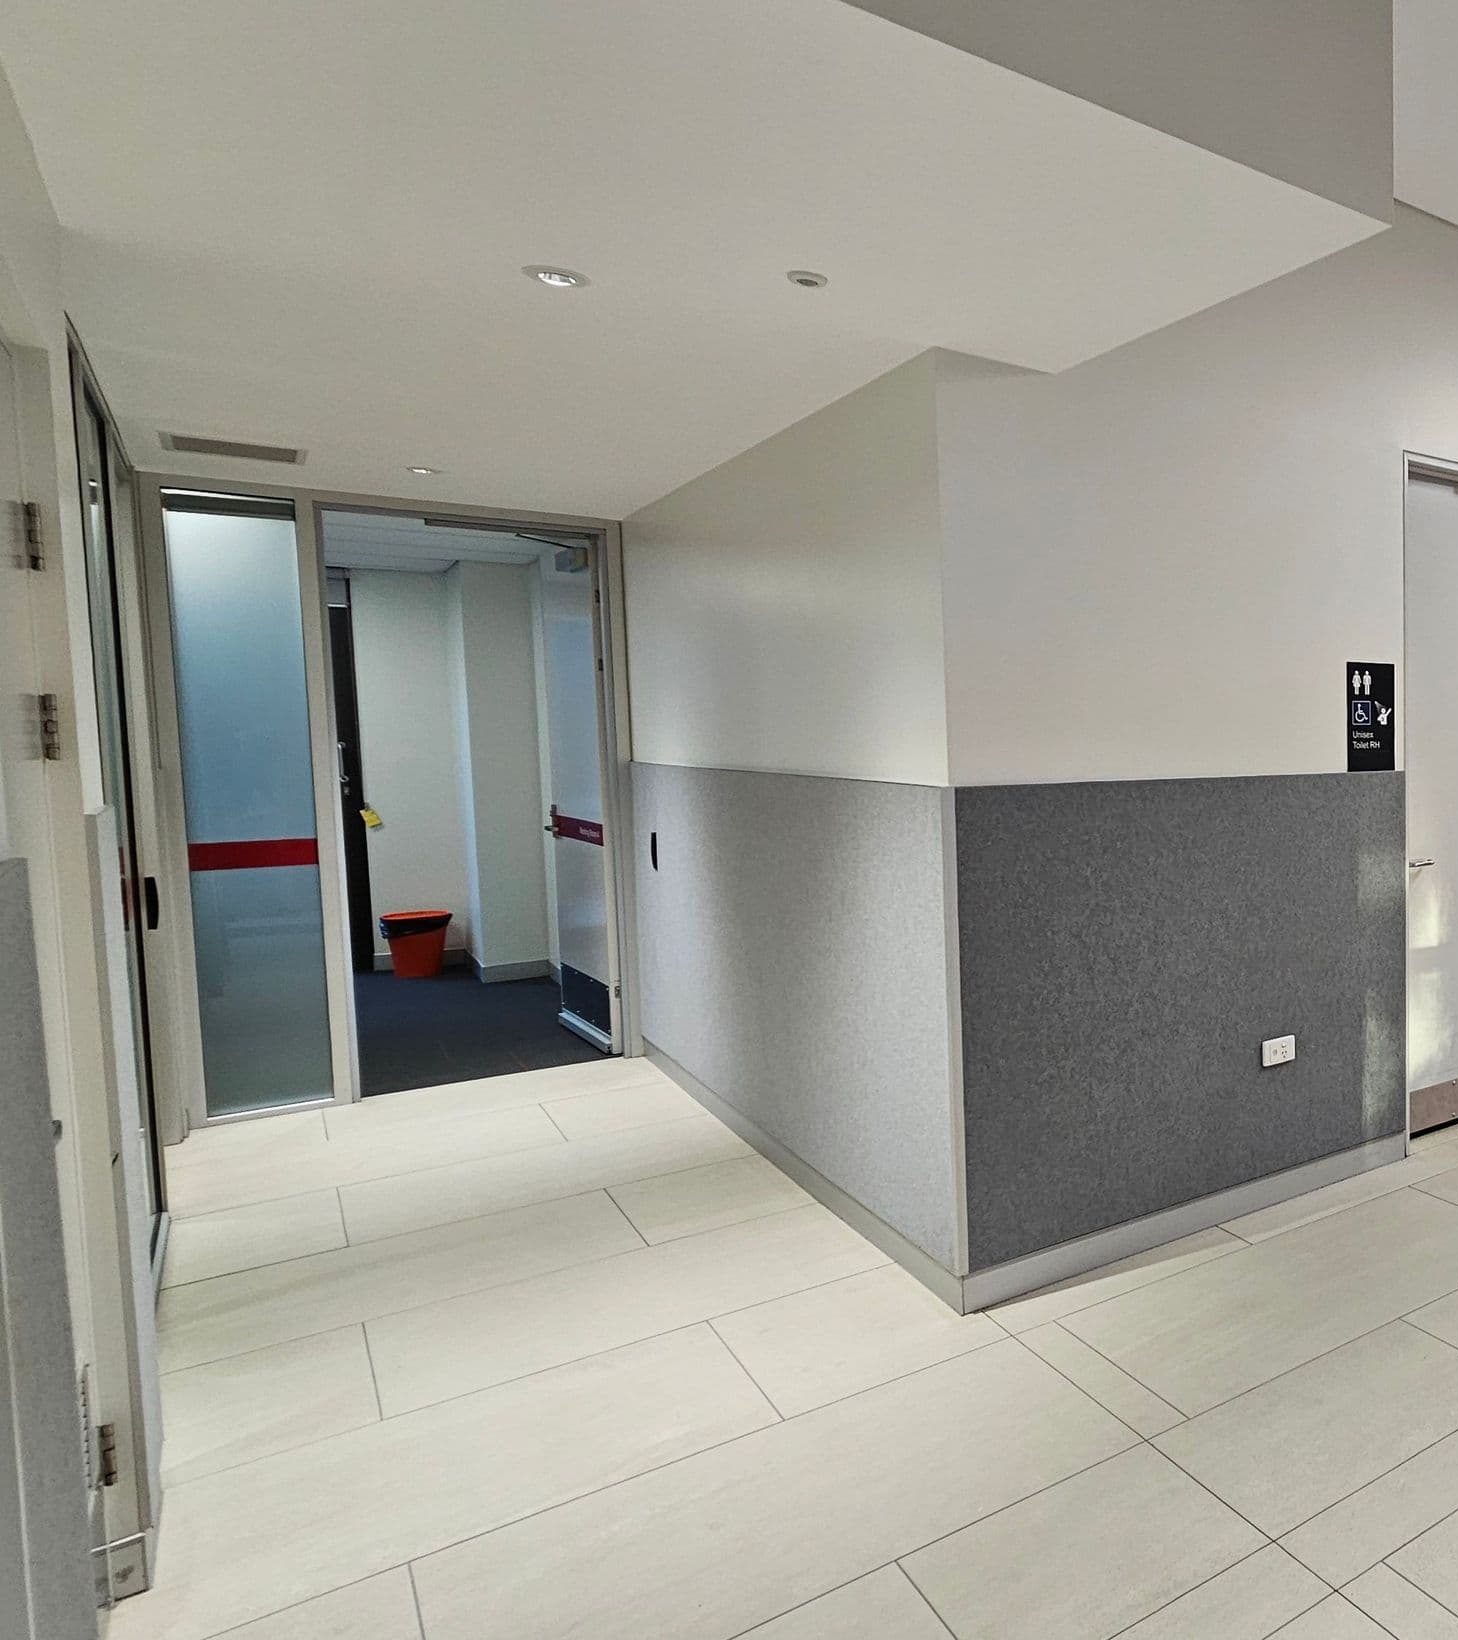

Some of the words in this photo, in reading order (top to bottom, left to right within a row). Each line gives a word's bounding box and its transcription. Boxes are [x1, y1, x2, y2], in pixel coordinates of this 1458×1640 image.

[1352, 731, 1374, 739] Unisex
[1352, 741, 1369, 749] Toilet
[1369, 741, 1380, 749] RH
